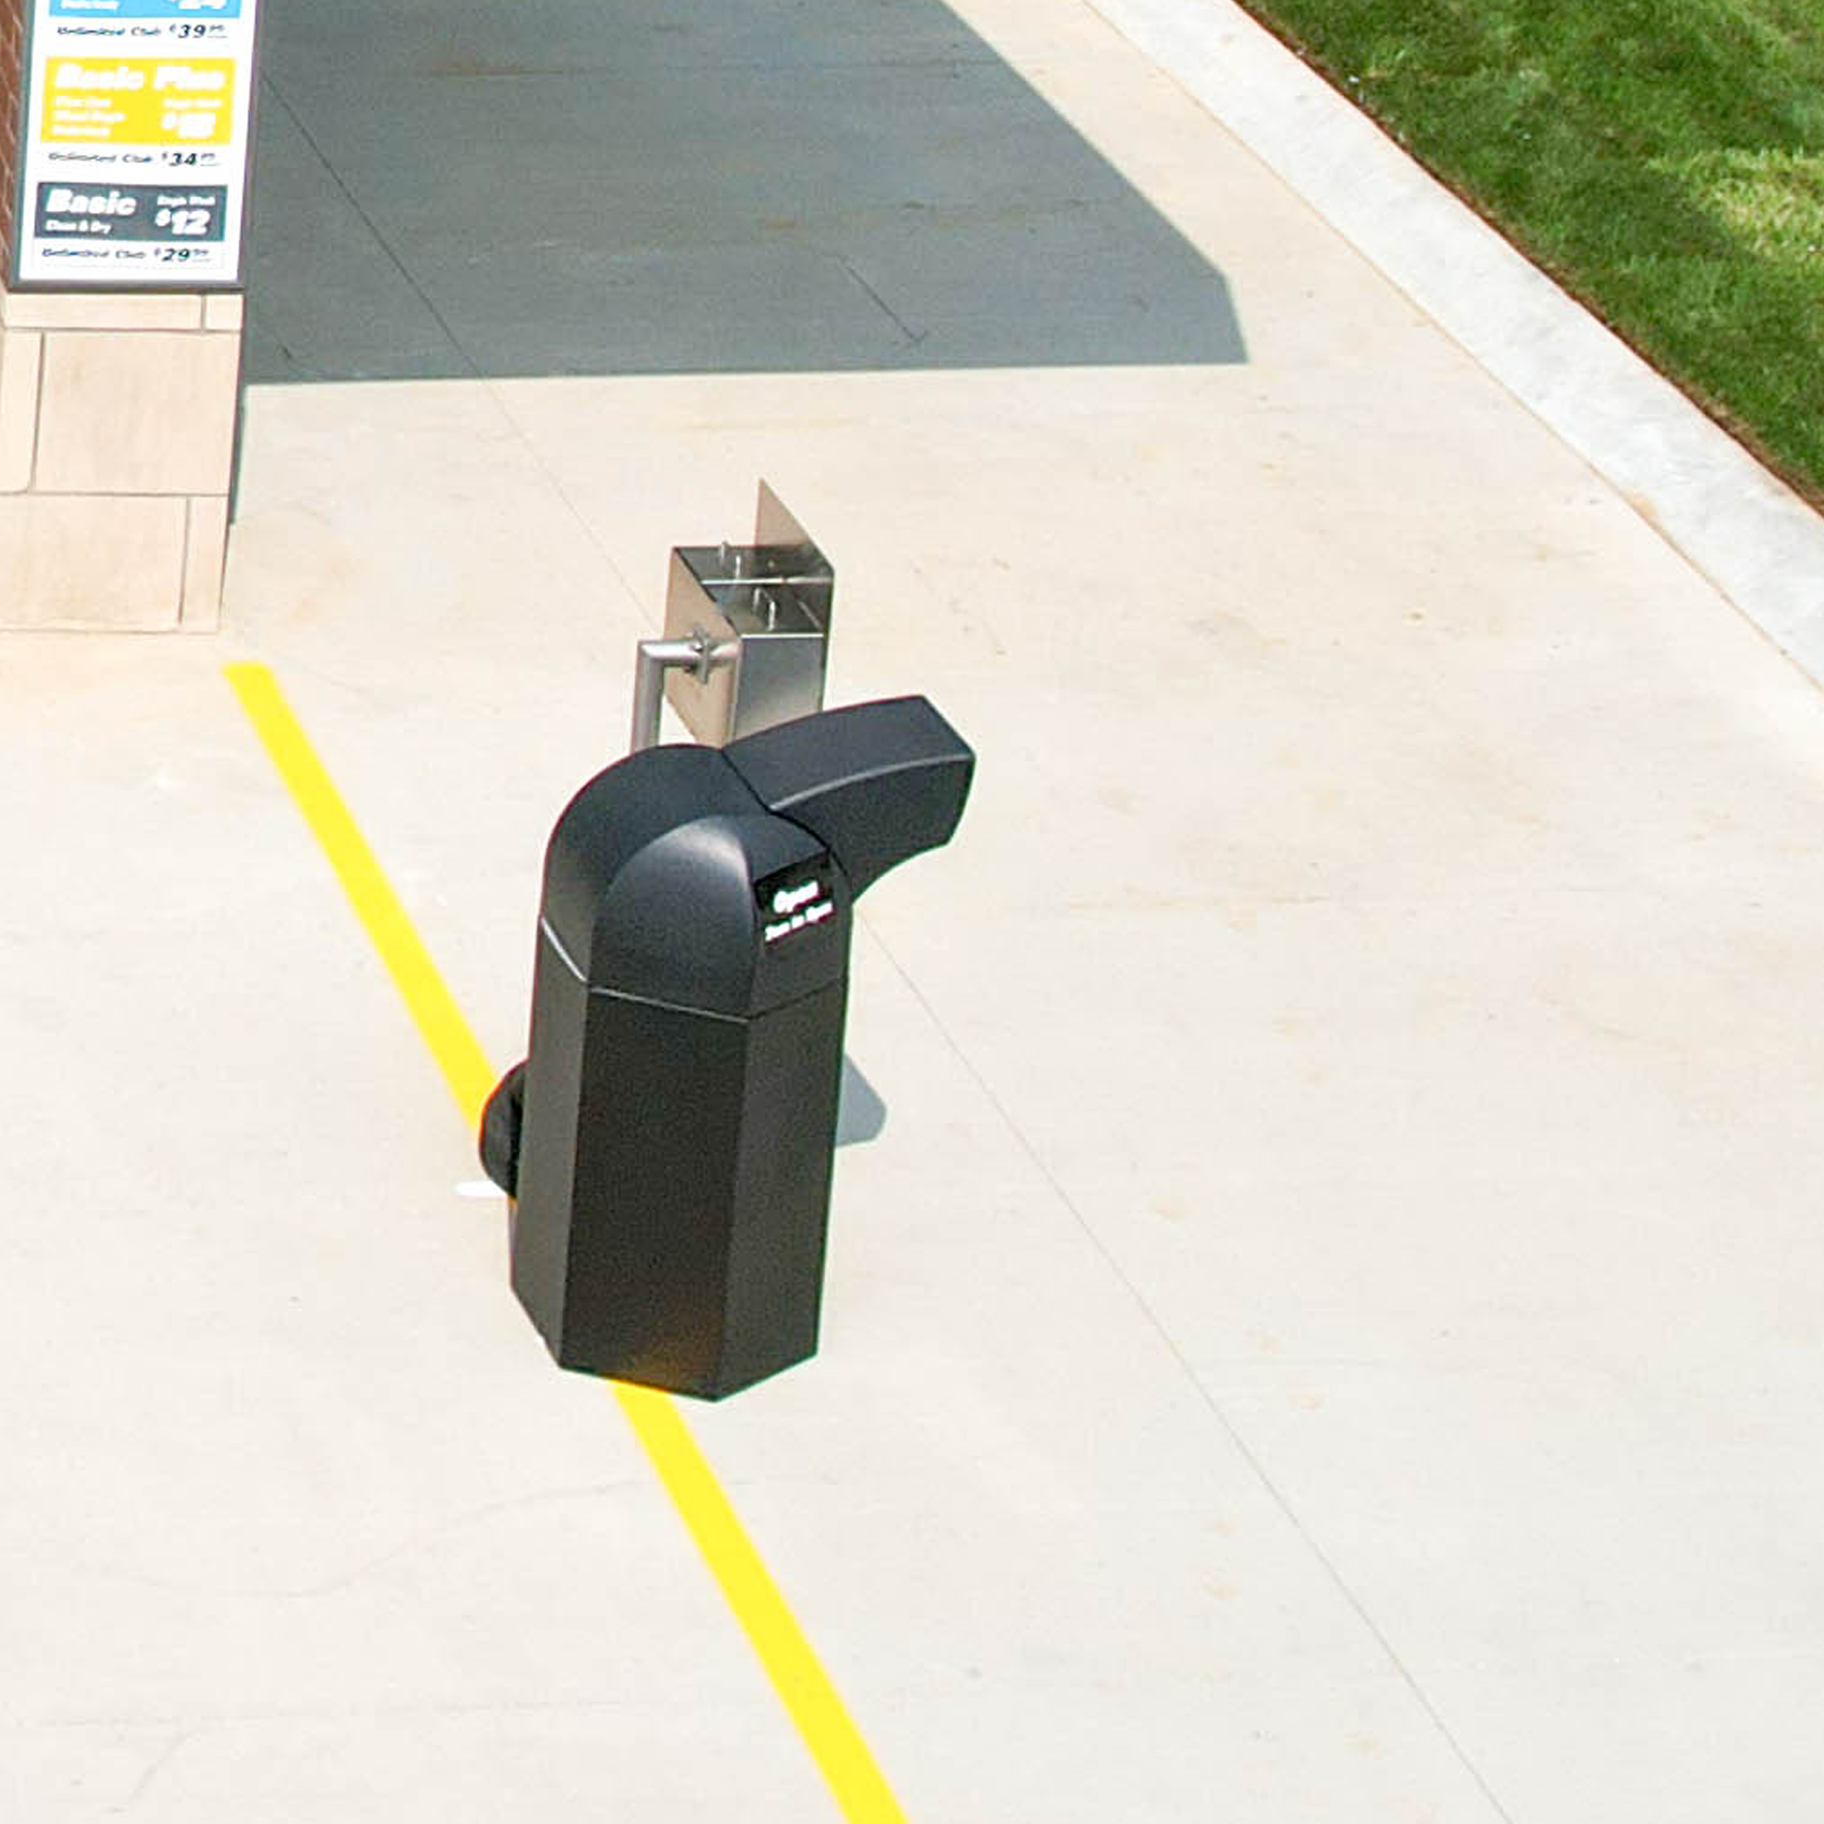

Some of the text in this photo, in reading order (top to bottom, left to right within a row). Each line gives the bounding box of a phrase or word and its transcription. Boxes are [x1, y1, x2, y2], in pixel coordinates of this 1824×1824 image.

[55, 63, 225, 90] Basic Plus
[45, 188, 137, 216] Basic
[155, 209, 211, 236] $12
[773, 880, 819, 914] Open
